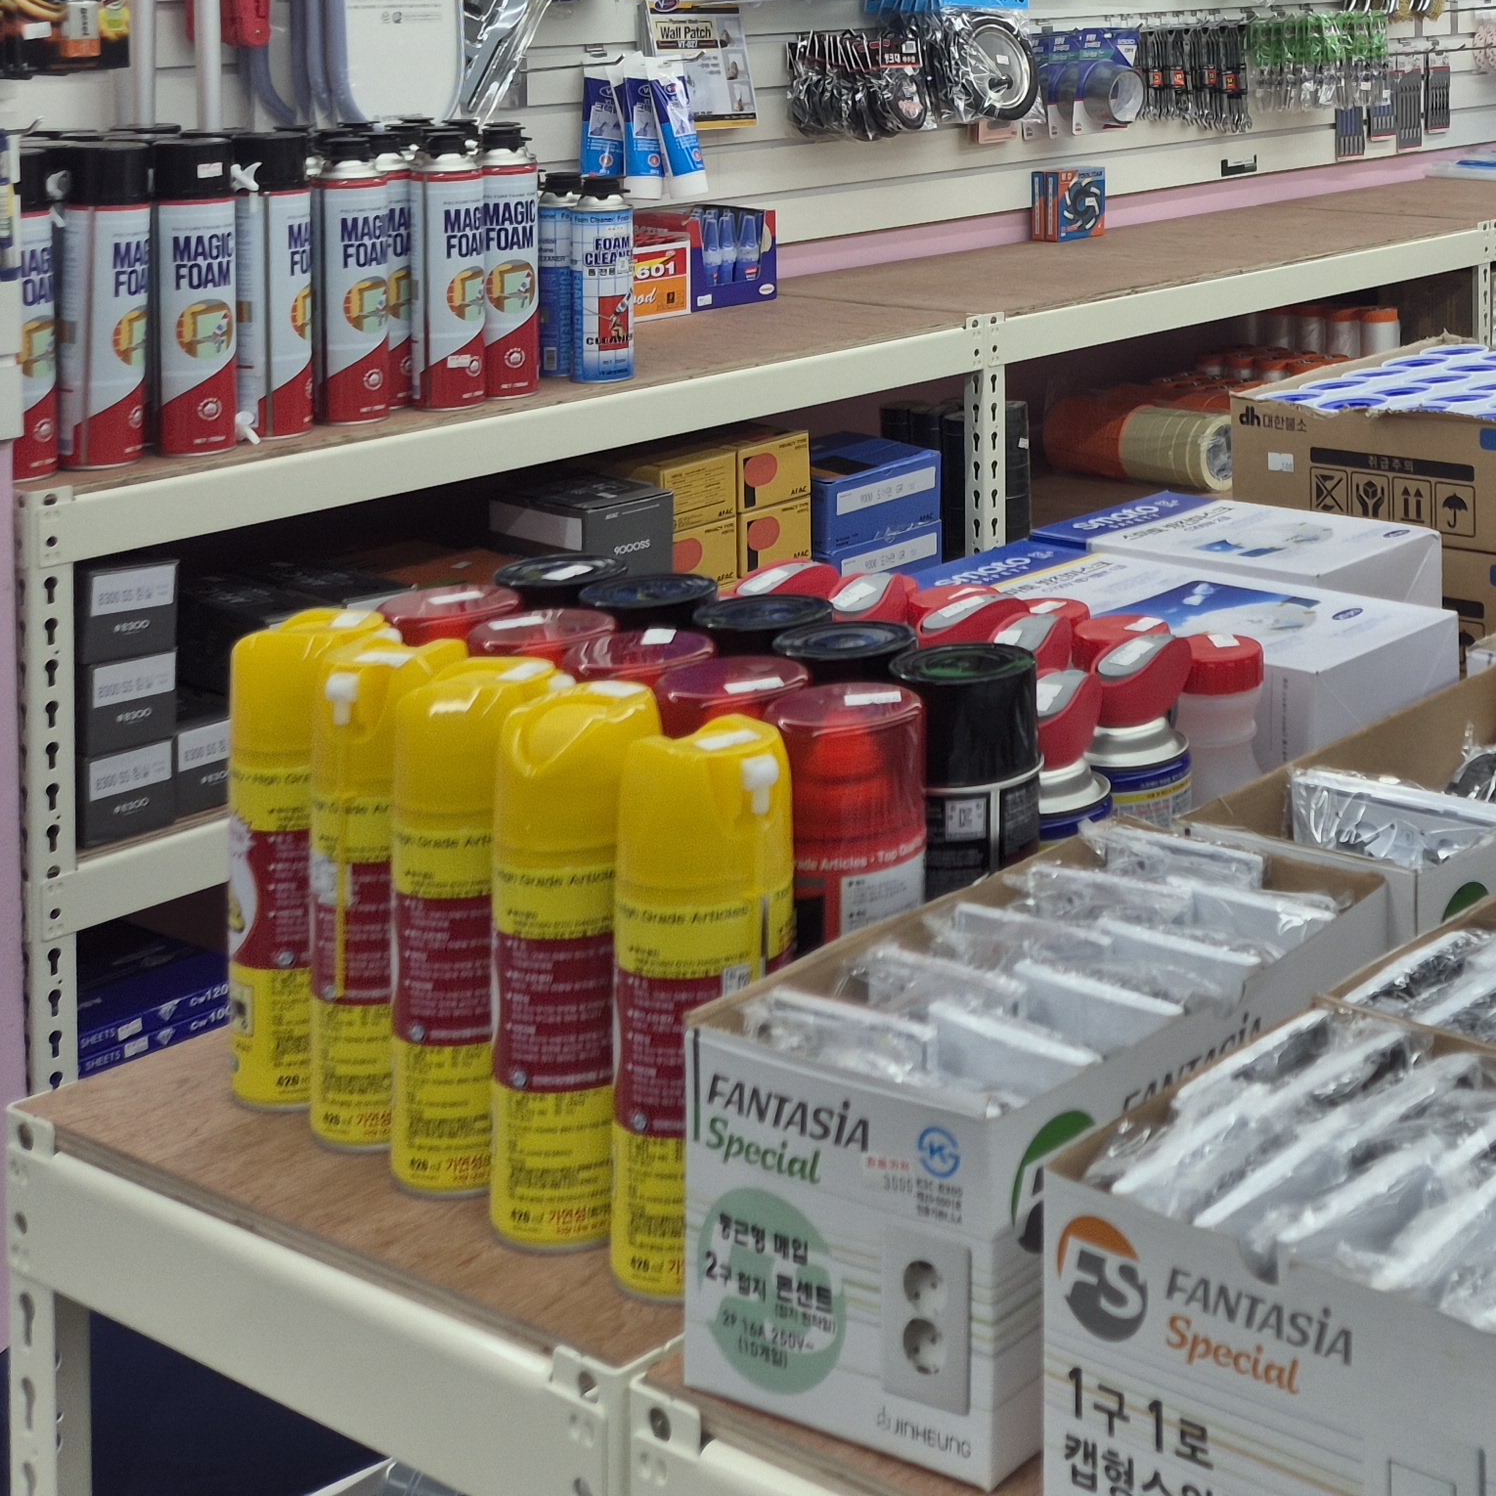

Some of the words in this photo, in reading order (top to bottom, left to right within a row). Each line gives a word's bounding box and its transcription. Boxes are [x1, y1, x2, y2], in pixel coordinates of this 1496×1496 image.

[660, 26, 681, 40] Wall
[683, 26, 712, 40] Patch
[483, 199, 535, 227] MAGIC
[172, 232, 234, 263] MAGIC
[485, 225, 534, 252] FOAM
[595, 236, 630, 254] FOAM
[175, 261, 231, 291] FOAM
[1239, 405, 1261, 428] dh
[1072, 504, 1160, 531] smato
[933, 555, 1032, 588] smato
[80, 1027, 116, 1049] SHEETS
[85, 1051, 121, 1072] SHEETS
[706, 1116, 821, 1185] Special
[774, 1232, 808, 1266] 매입
[776, 1273, 833, 1314] 콘센트
[1166, 1315, 1300, 1394] Special
